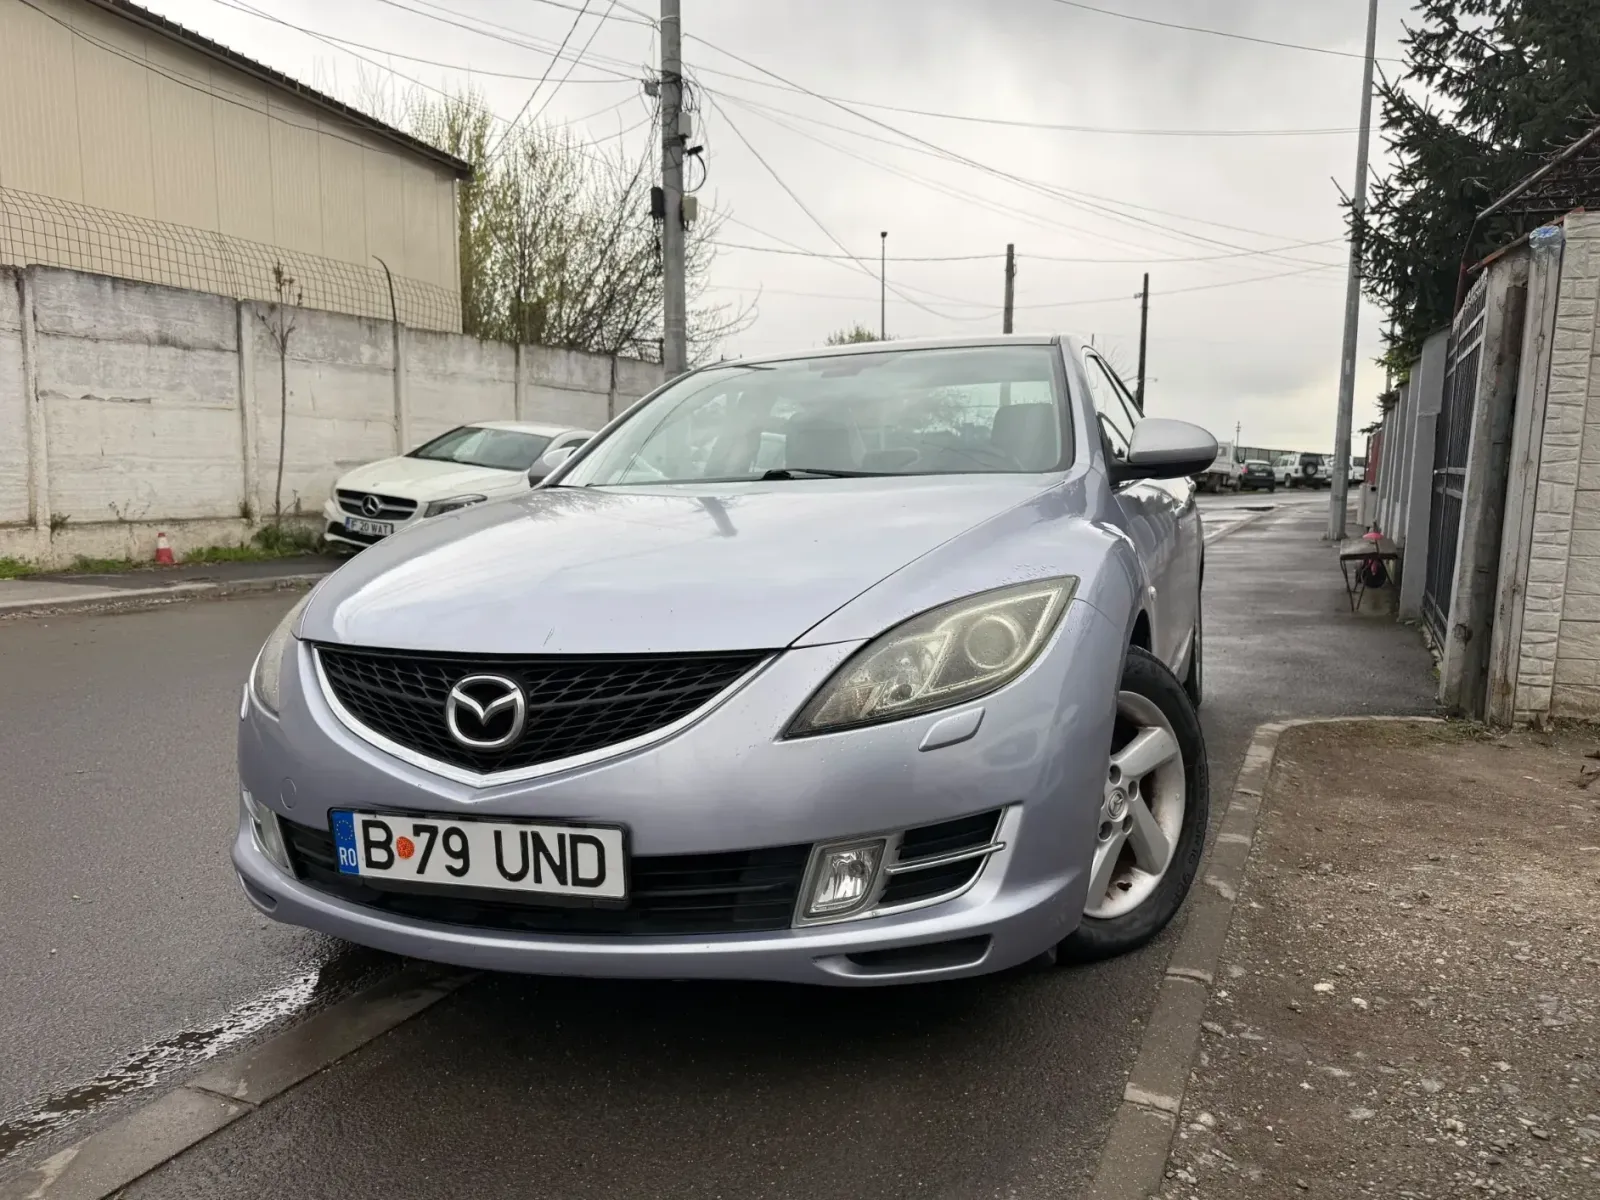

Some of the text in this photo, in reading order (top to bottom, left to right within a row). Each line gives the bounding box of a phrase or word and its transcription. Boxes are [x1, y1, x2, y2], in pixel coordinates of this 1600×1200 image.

[360, 521, 370, 531] 20
[371, 523, 388, 534] WAT
[339, 846, 357, 867] RO
[361, 819, 606, 889] B 79 UND
